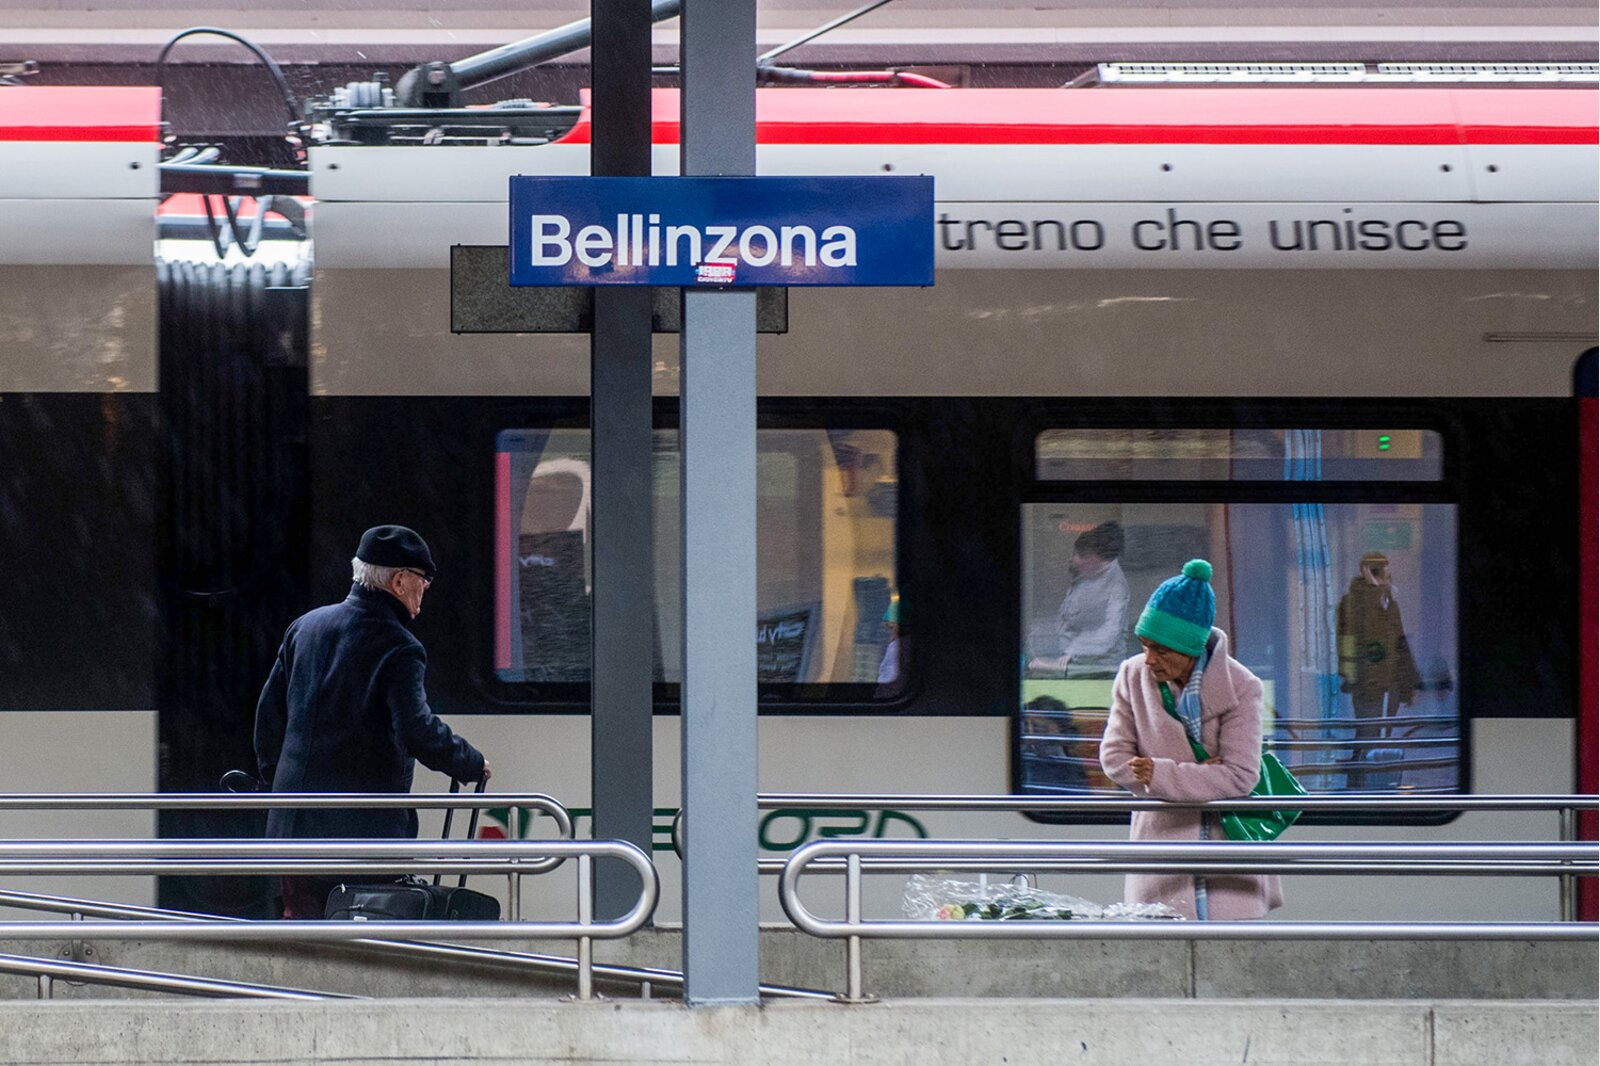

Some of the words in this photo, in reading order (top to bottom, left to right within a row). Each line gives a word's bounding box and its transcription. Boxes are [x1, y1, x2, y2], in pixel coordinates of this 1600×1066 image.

[531, 213, 858, 267] Bellinzona
[937, 211, 1106, 252] treno
[1131, 207, 1242, 252] che
[1268, 207, 1468, 252] unisce
